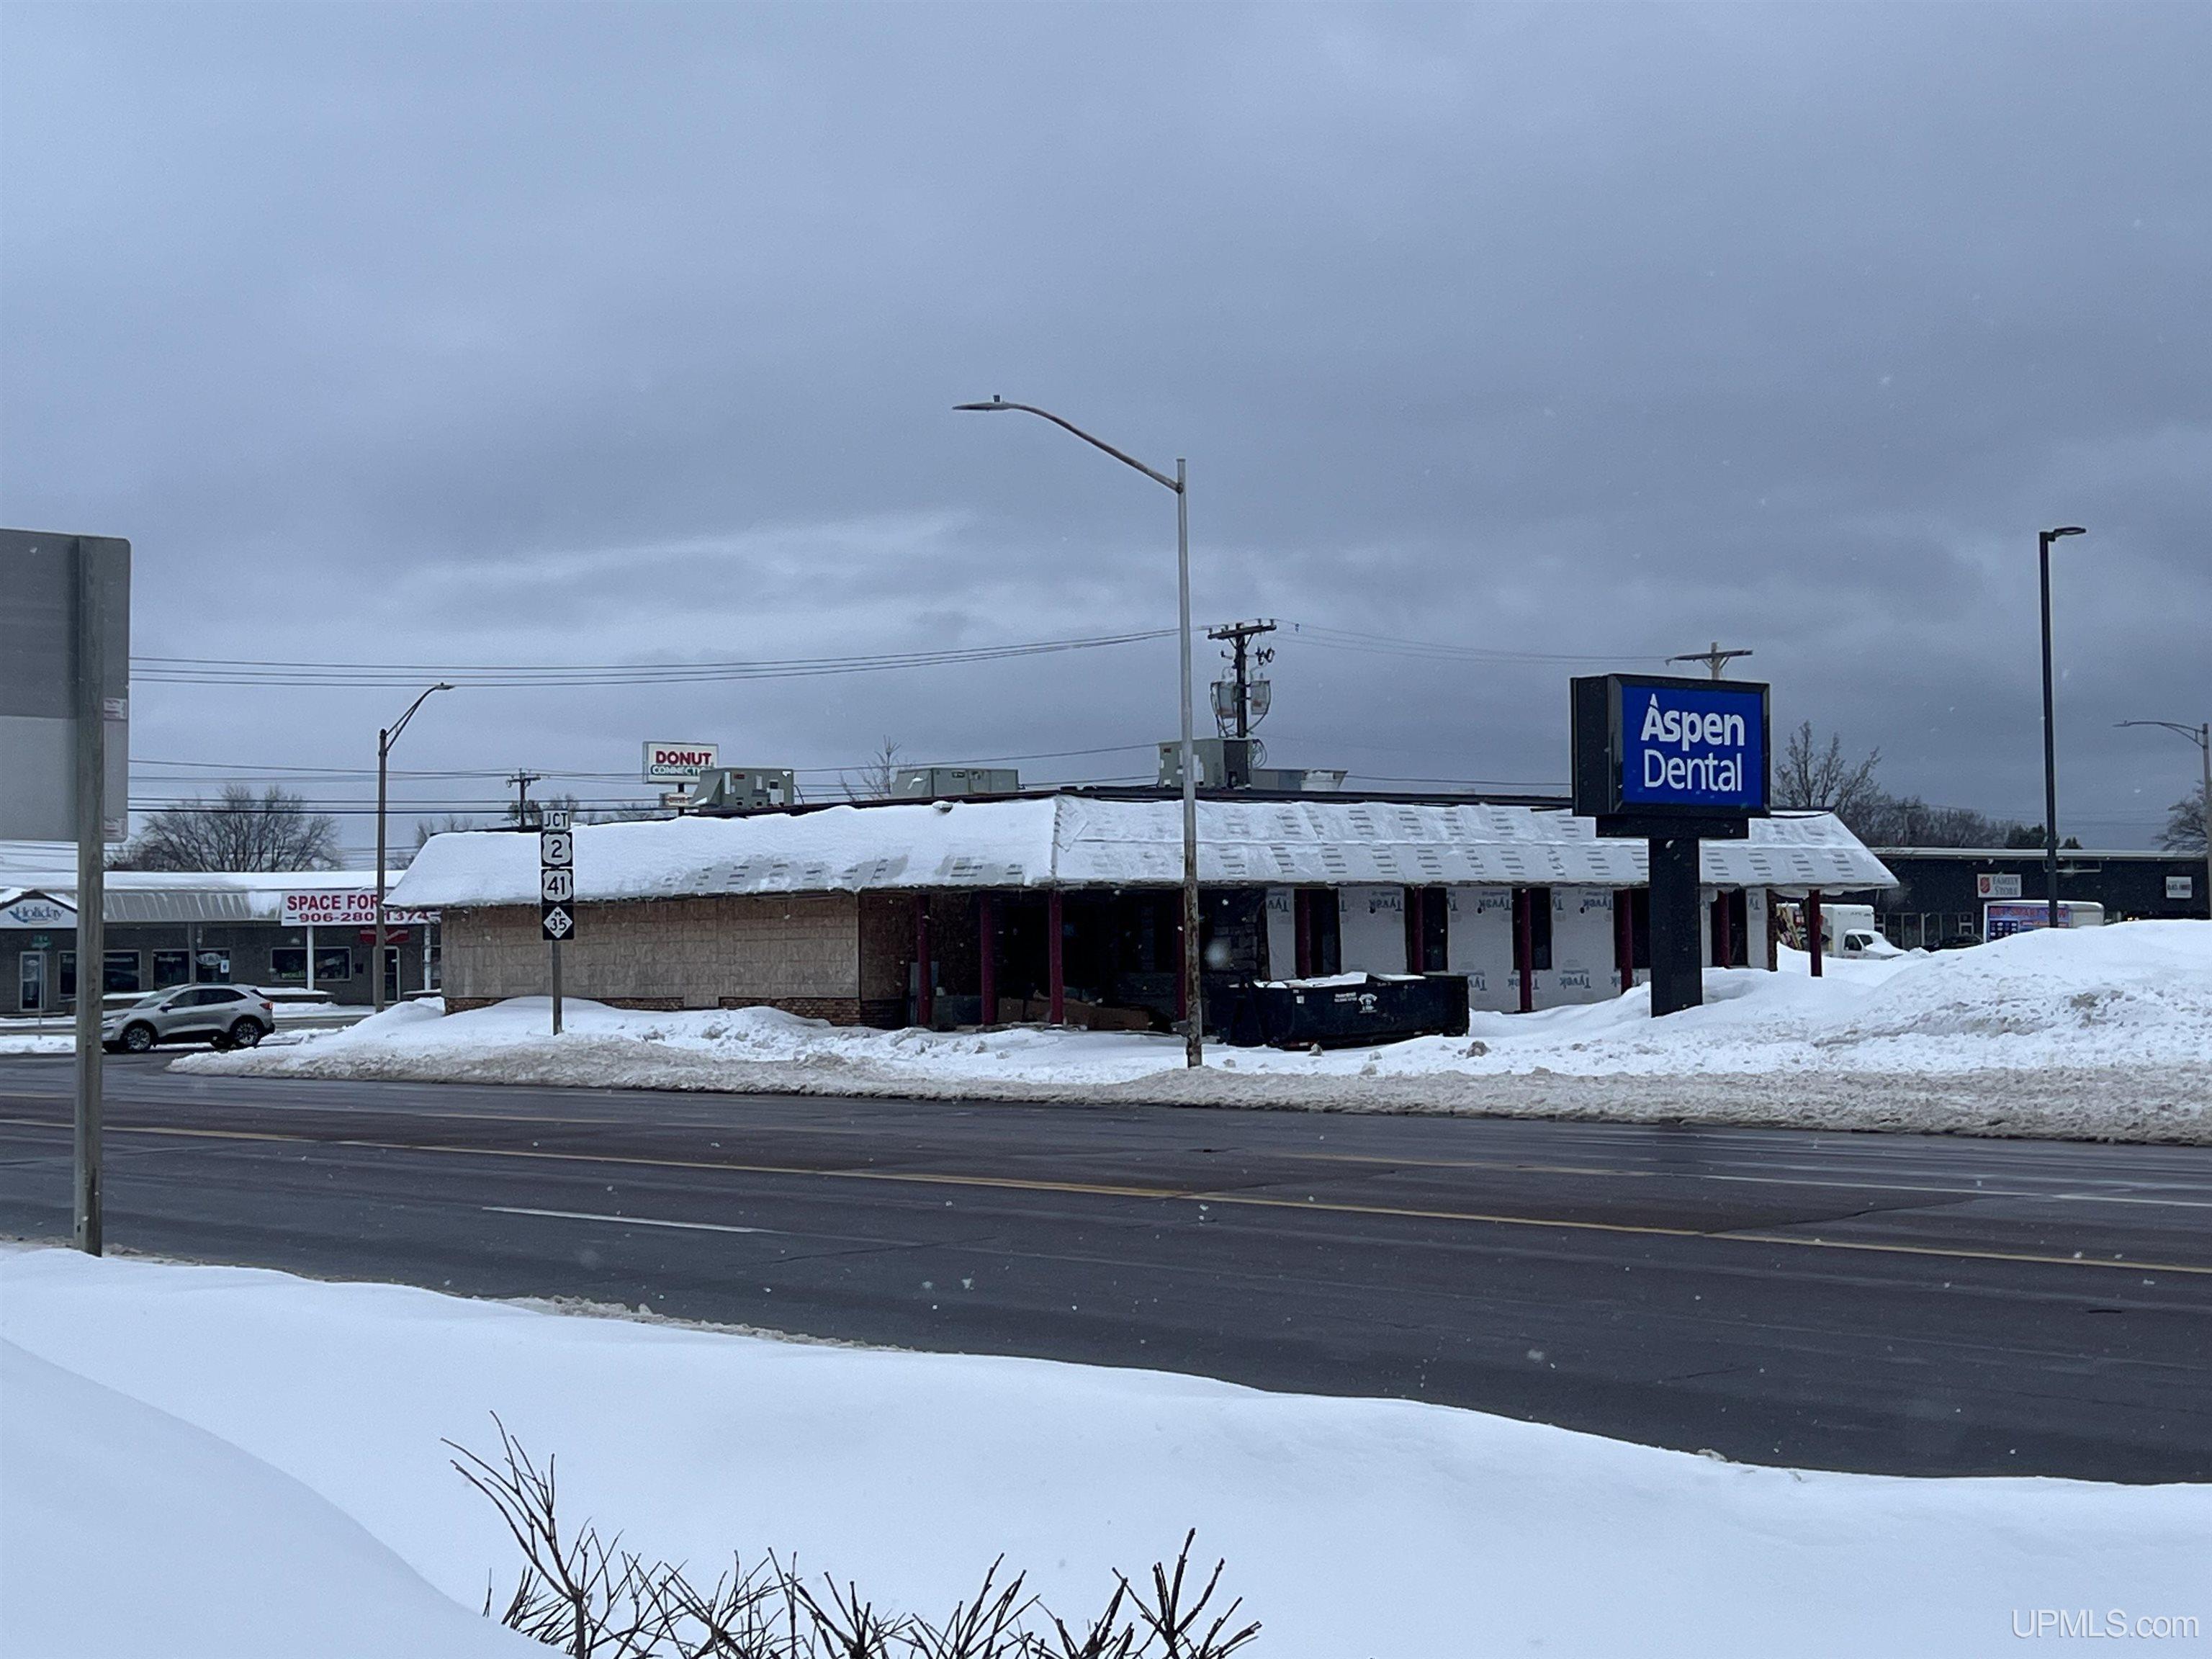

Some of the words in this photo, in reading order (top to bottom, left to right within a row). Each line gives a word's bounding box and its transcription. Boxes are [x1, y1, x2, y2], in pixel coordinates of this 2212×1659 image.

[1640, 693, 1745, 751] Aspen
[656, 750, 712, 765] DONUT
[652, 765, 701, 775] CONNECTI
[1644, 749, 1742, 791] Dental
[544, 812, 567, 827] JCT
[551, 839, 563, 858] 2
[547, 876, 565, 895] 41
[287, 895, 341, 911] SPACE
[1478, 898, 1511, 911] Tyvek
[1583, 898, 1614, 911] Tyvek
[549, 917, 567, 931] 35
[1560, 975, 1591, 989] Tyvek
